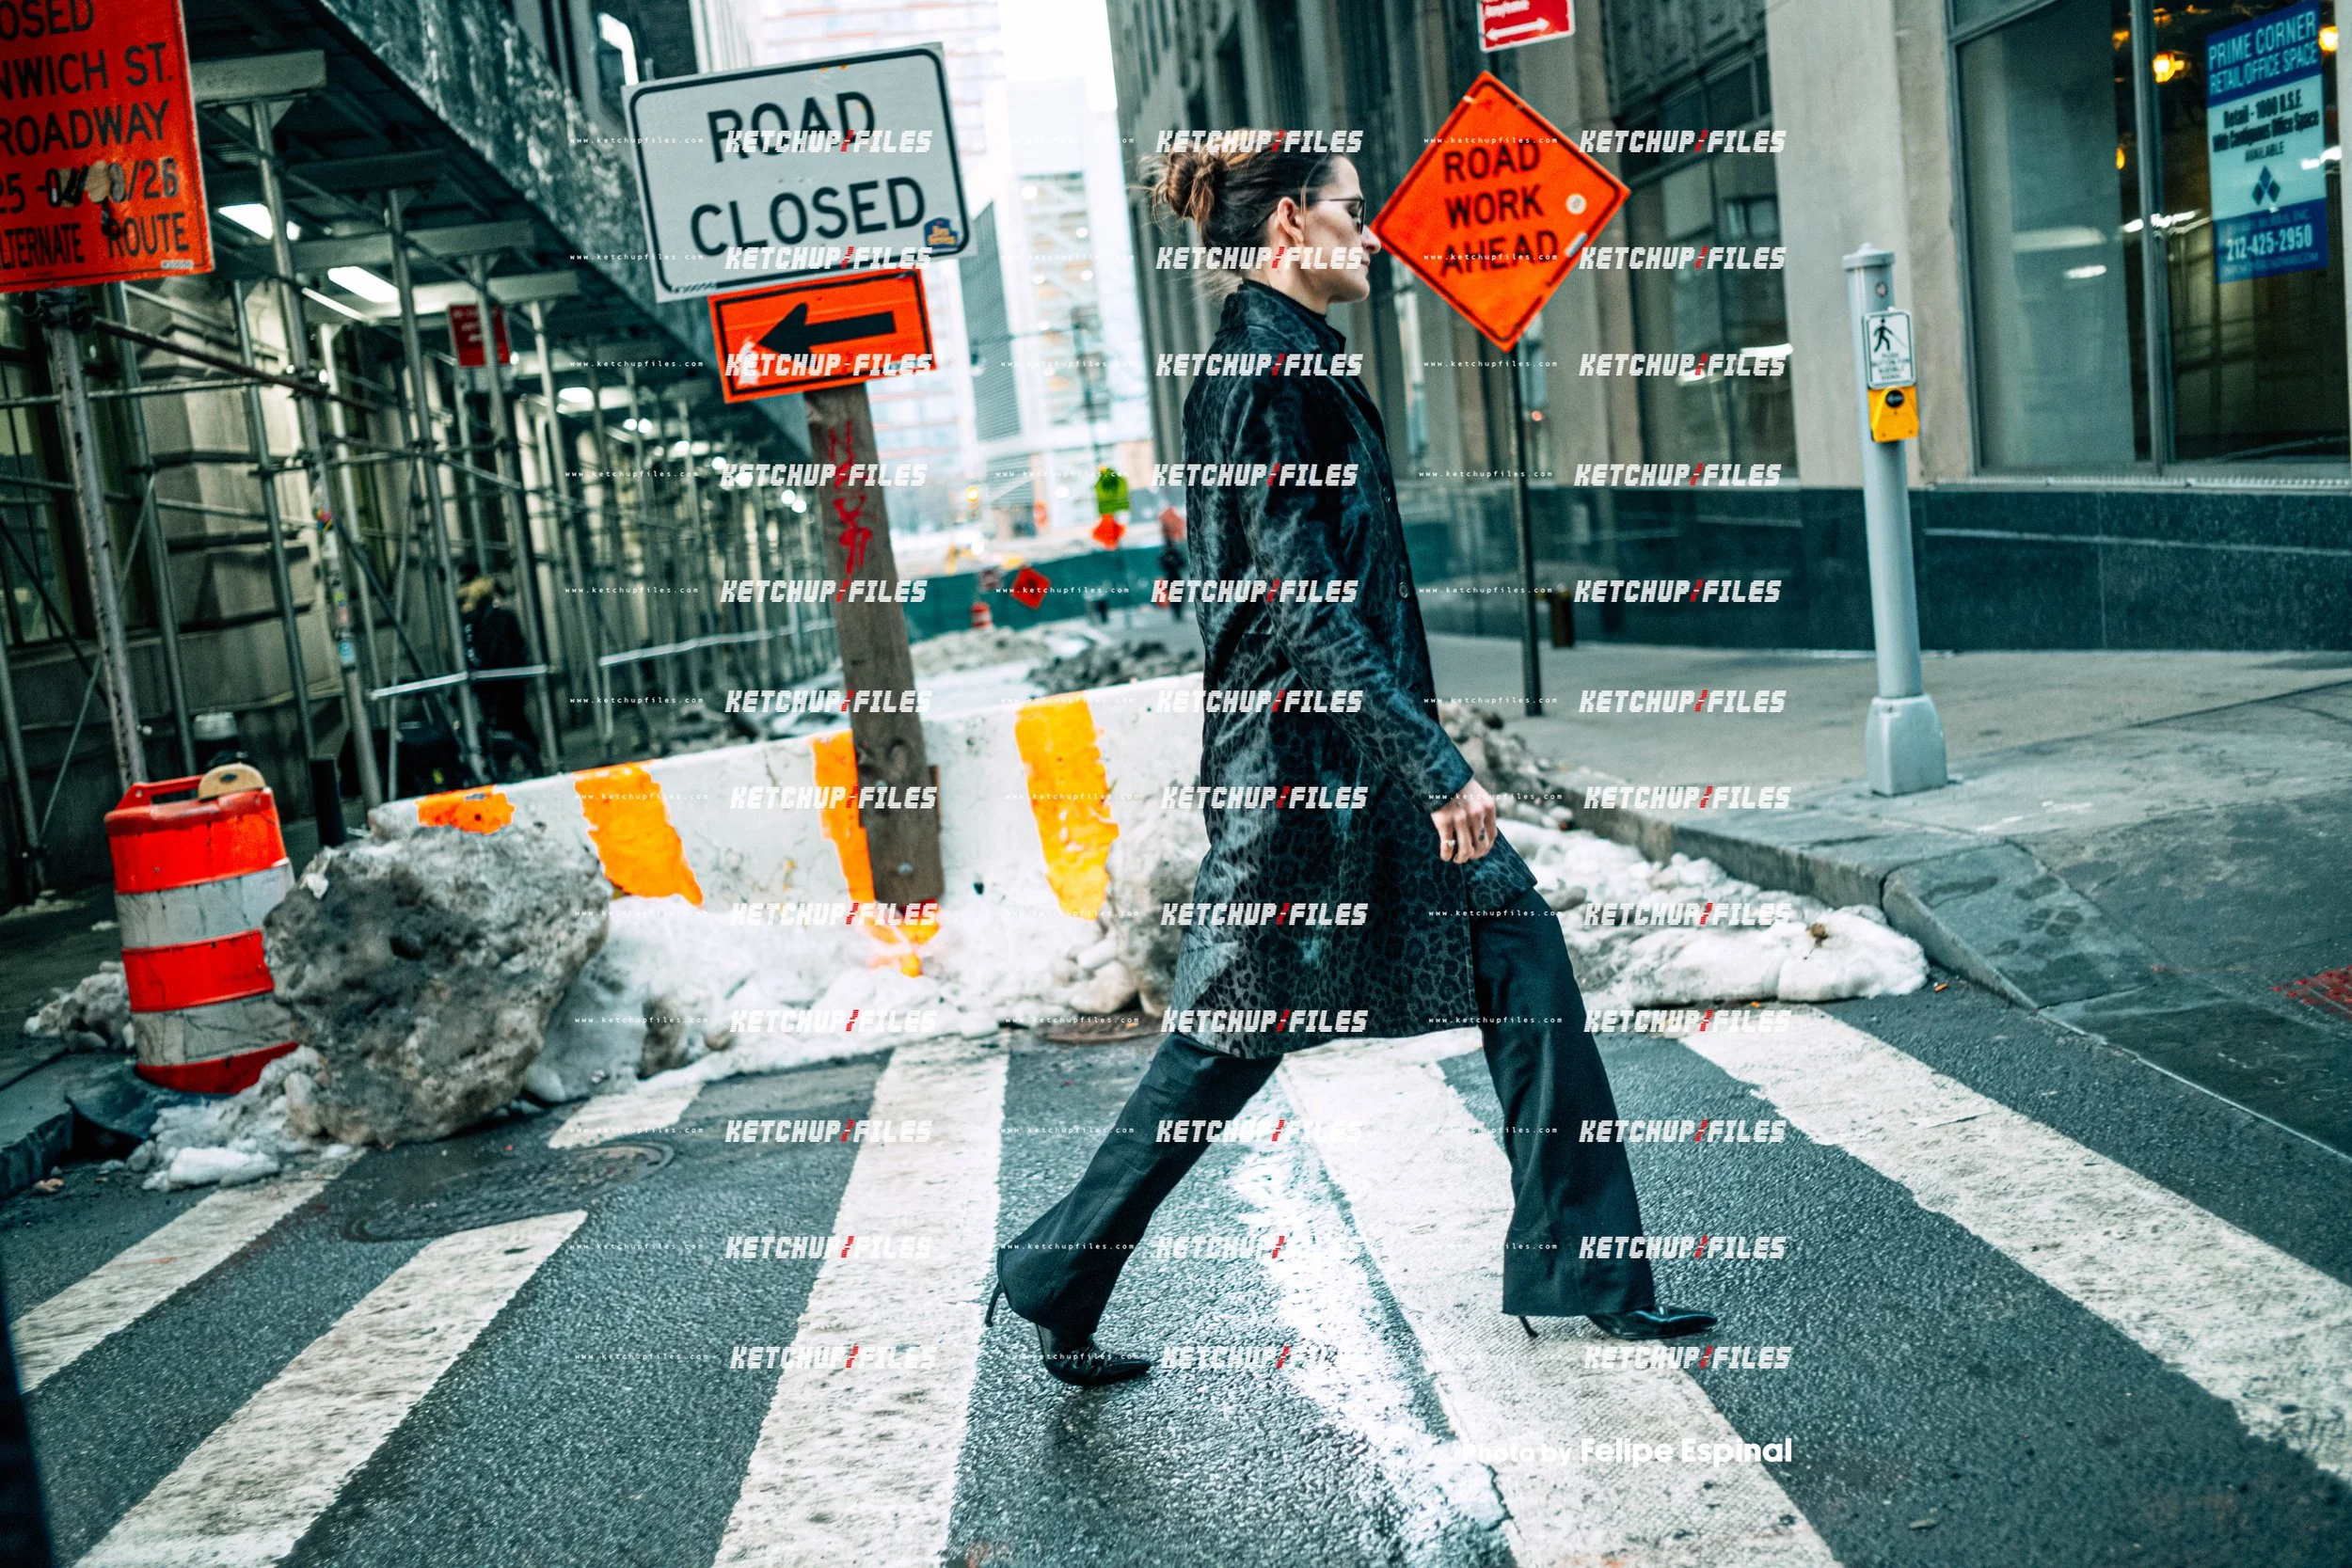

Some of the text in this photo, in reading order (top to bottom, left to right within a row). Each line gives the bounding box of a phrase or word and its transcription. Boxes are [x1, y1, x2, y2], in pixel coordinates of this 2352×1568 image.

[2208, 9, 2316, 71] PRIME CORNER
[2281, 40, 2319, 72] SPACE
[124, 42, 173, 87] ST.
[707, 91, 875, 163] ROAD
[1444, 140, 1540, 184] ROAD
[691, 176, 925, 257] CLOSED
[1445, 184, 1544, 230] WORK
[107, 213, 190, 259] ROUTE
[1439, 230, 1559, 277] AHEAD
[2226, 222, 2313, 262] 212-425-2950
